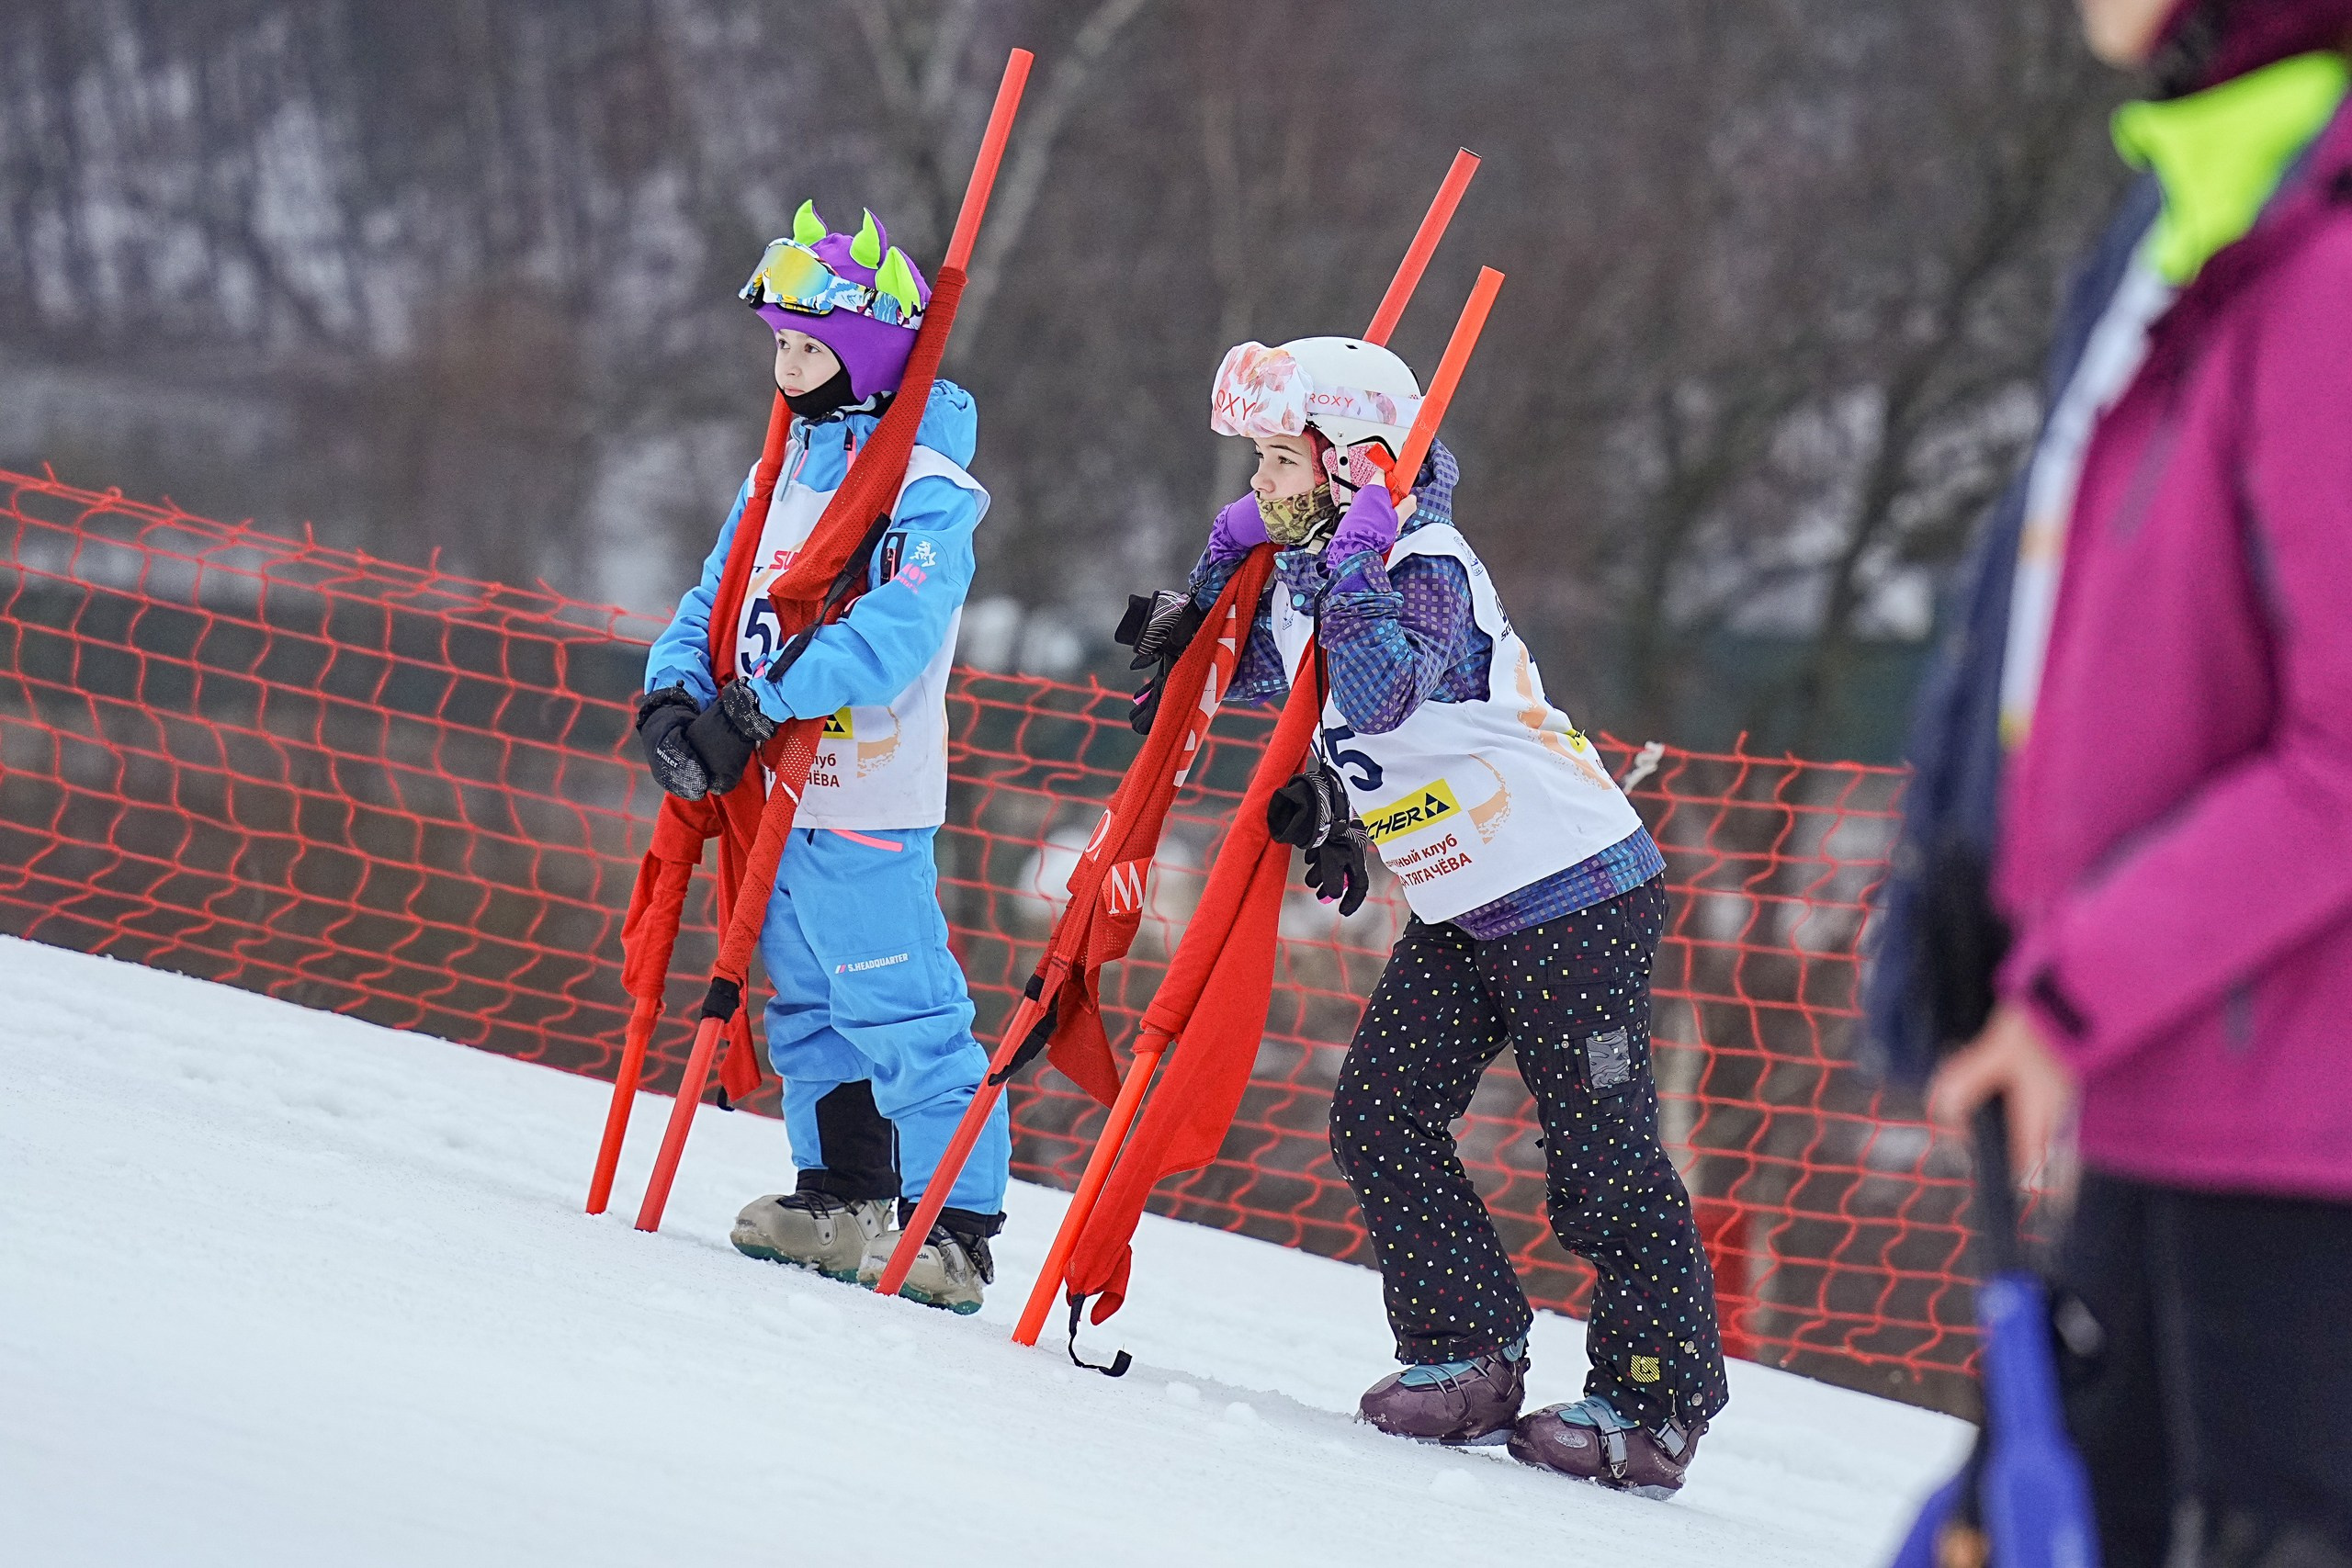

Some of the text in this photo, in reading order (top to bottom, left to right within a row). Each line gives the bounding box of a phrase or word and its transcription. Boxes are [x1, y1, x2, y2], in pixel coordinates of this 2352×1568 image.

[1309, 392, 1354, 408] ROXY
[811, 752, 837, 769] луб
[1314, 724, 1384, 792] 5
[1366, 807, 1425, 840] CHER
[1420, 832, 1458, 859] клуб
[1405, 852, 1473, 886] ТЯГАЧЁВА
[846, 952, 909, 973] S.HEADQUARTER
